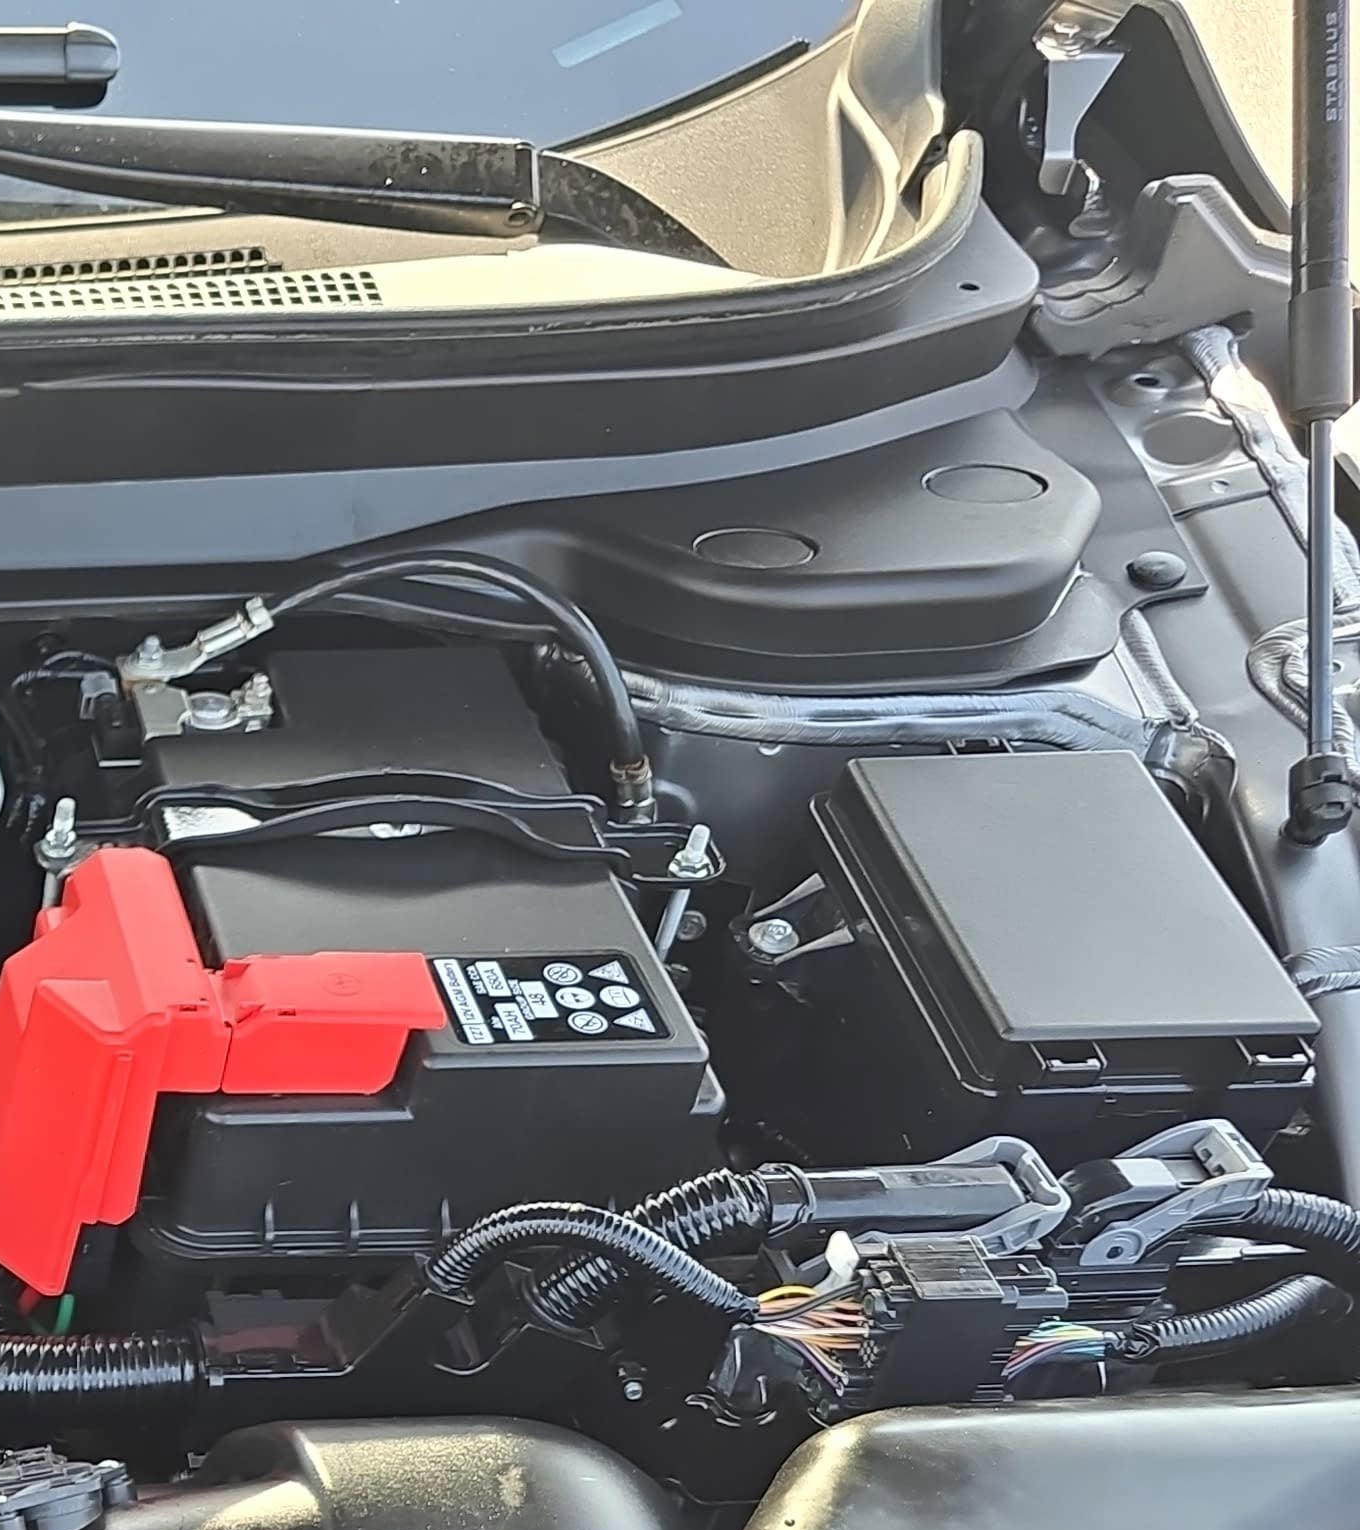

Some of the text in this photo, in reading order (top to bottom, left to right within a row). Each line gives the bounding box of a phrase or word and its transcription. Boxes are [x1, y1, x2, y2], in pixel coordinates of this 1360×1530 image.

[1326, 11, 1338, 122] STABILUS
[452, 988, 469, 1008] AGM
[528, 993, 546, 1007] 48
